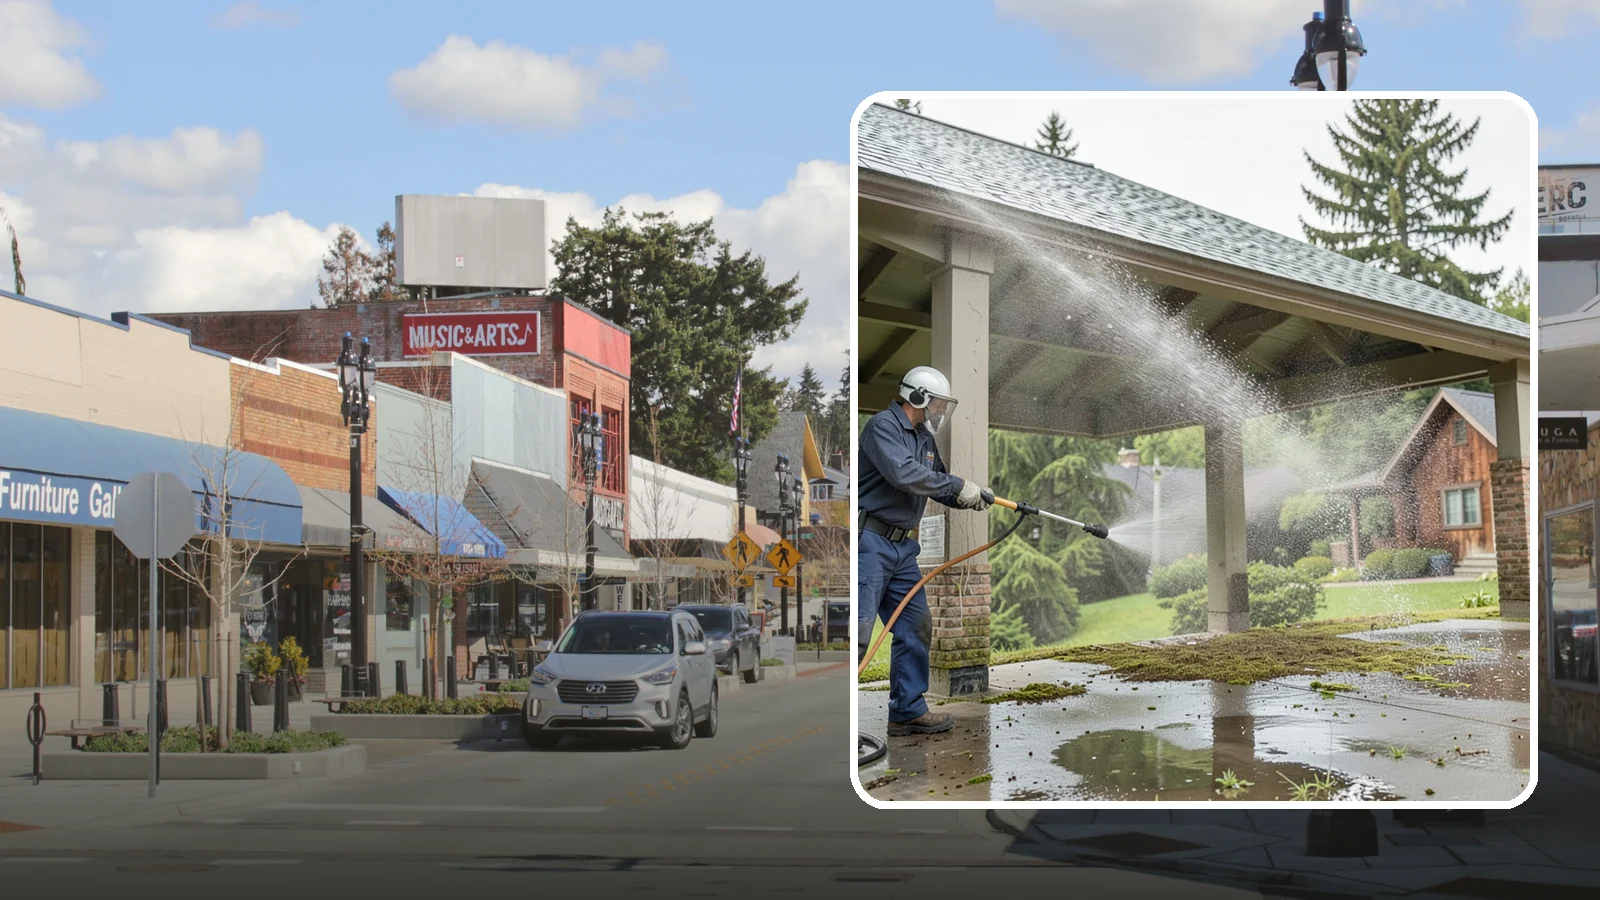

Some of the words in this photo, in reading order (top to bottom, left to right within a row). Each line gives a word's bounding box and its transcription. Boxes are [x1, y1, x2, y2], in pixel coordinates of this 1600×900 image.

[0, 471, 79, 516] Furniture
[89, 482, 122, 519] Gal
[453, 563, 480, 575] SUSHI
